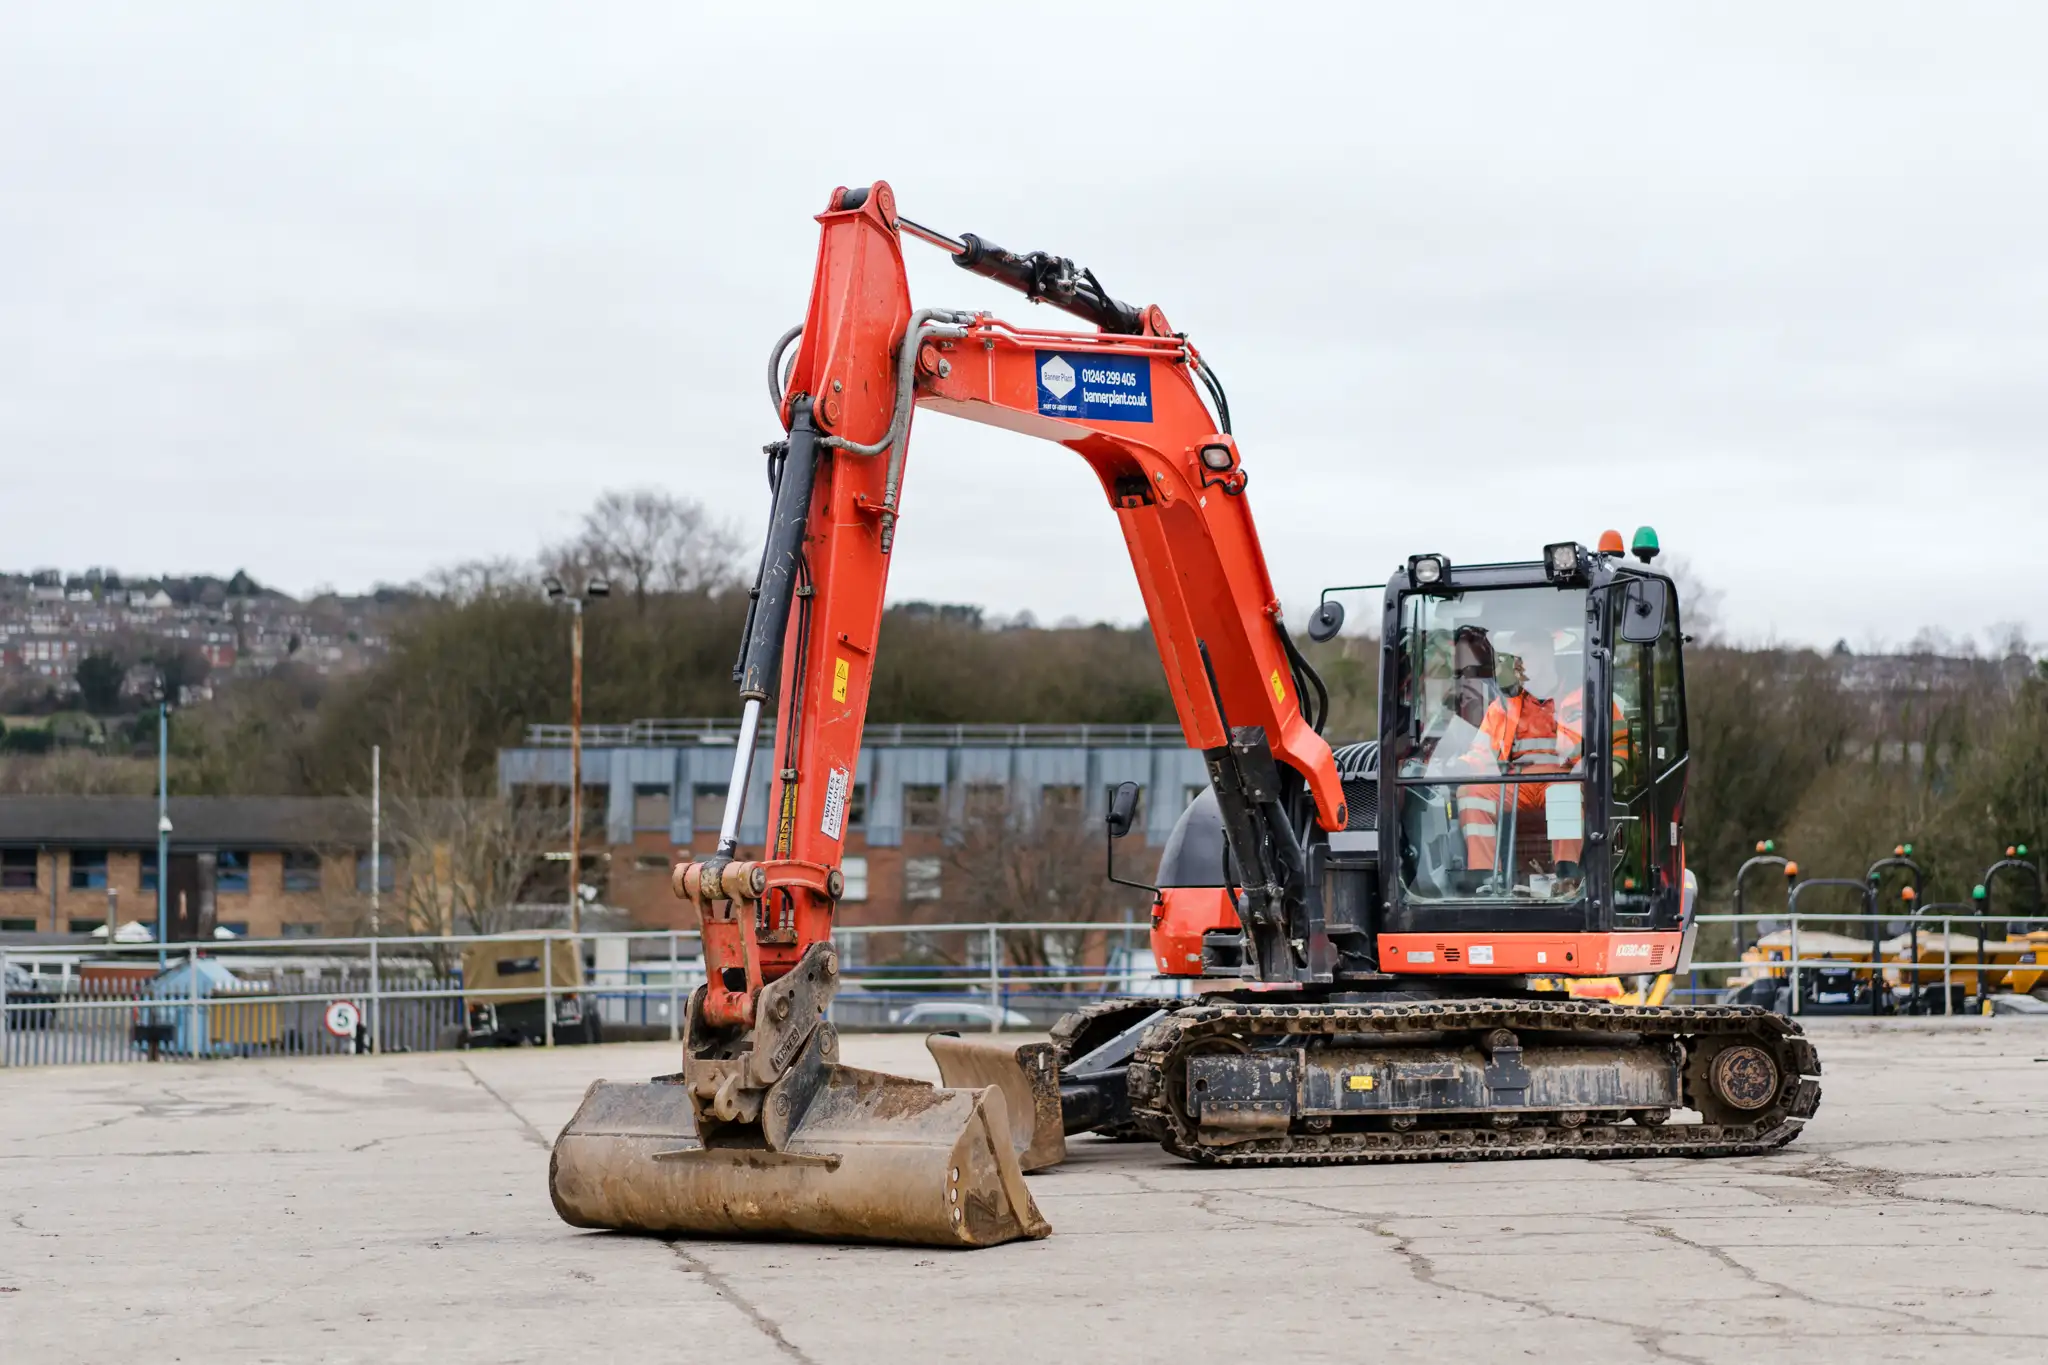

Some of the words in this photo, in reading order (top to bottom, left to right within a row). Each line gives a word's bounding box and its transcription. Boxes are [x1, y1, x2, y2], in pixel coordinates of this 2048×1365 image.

[1044, 371, 1061, 381] Banner
[1082, 369, 1106, 384] 01246
[1106, 371, 1121, 385] 299
[1121, 373, 1136, 386] 405
[1083, 388, 1147, 407] bannerplant.co.uk
[825, 777, 835, 818] WHITES
[828, 778, 841, 831] TOTALOCK
[337, 1008, 349, 1027] 5
[775, 1032, 800, 1066] WHITES
